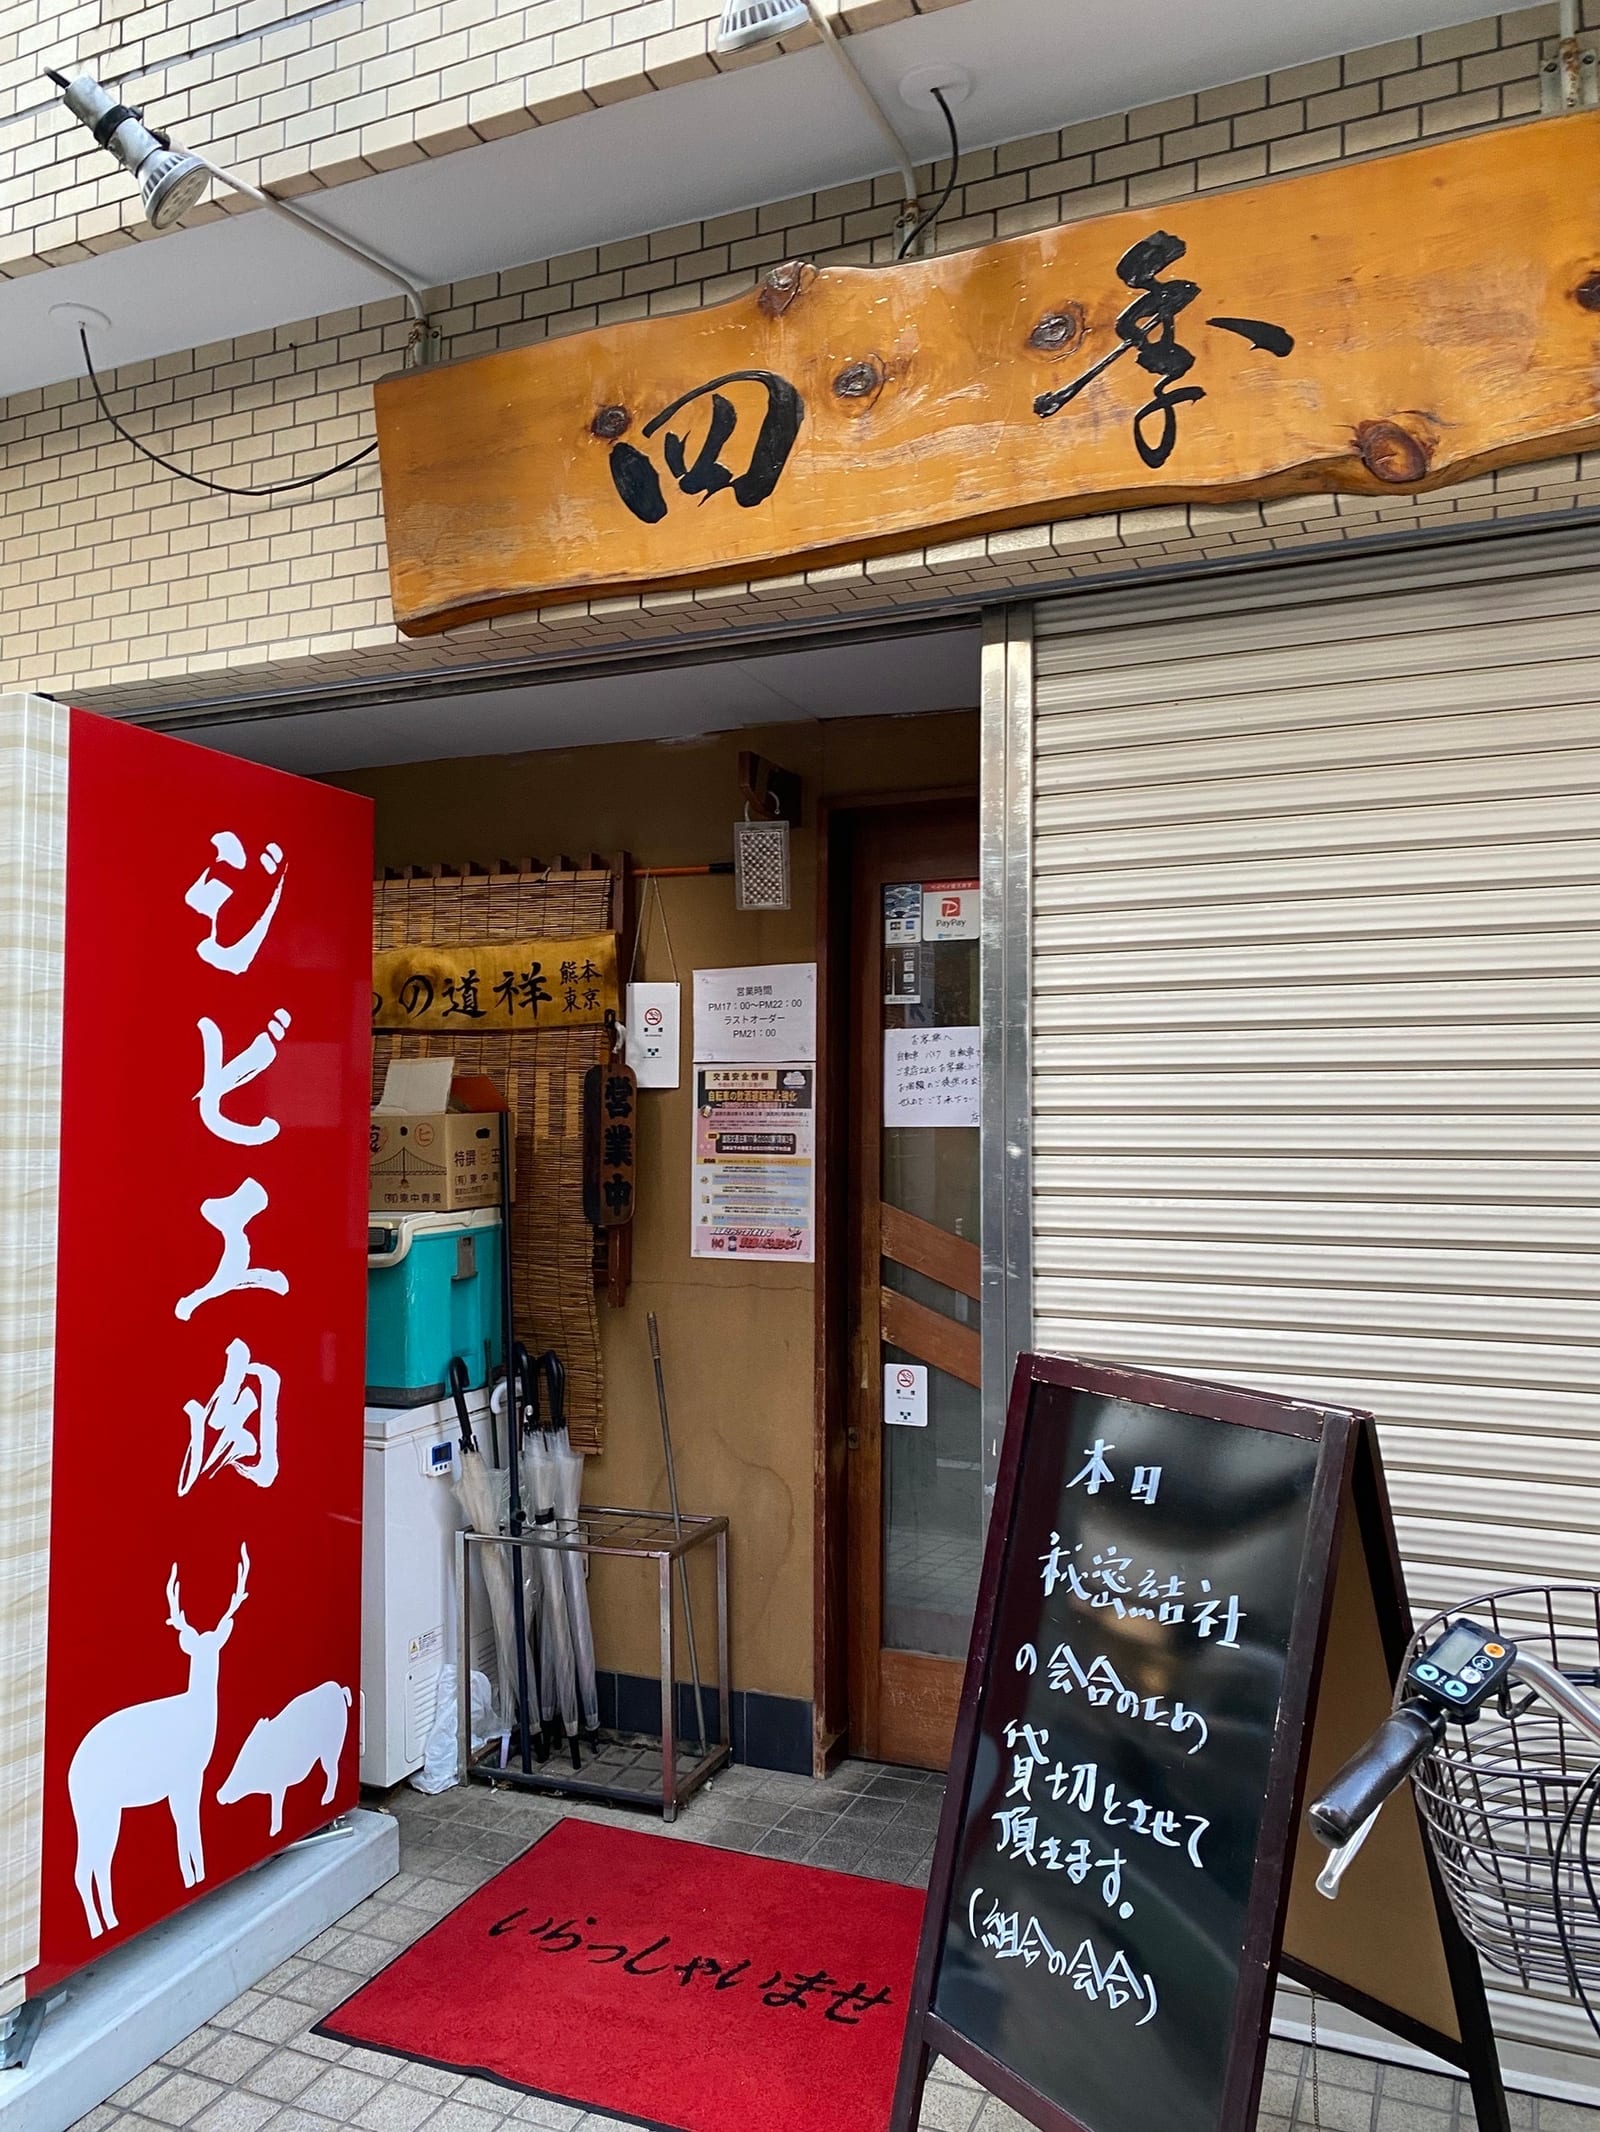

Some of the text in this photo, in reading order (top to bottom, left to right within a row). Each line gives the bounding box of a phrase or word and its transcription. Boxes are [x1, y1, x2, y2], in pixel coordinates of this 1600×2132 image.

[609, 230, 1294, 524] 四季
[559, 959, 602, 985] 熊本
[936, 920, 966, 928] PayPay
[372, 962, 552, 1019] の道祥
[562, 987, 600, 1013] 東京
[724, 1014, 785, 1025] ラストオーダー
[736, 985, 773, 996] 営業時間
[174, 830, 292, 1499] ジビエ肉
[604, 1075, 634, 1217] 営業中
[1065, 1439, 1163, 1505] 本日
[1038, 1531, 1247, 1649] 秘密結社
[1014, 1642, 1209, 1755] の会合のため
[1002, 1719, 1210, 1868] 貸切とさせて
[991, 1805, 1134, 1920] 頂きます。
[488, 1906, 894, 2025] いらっしゃいませ
